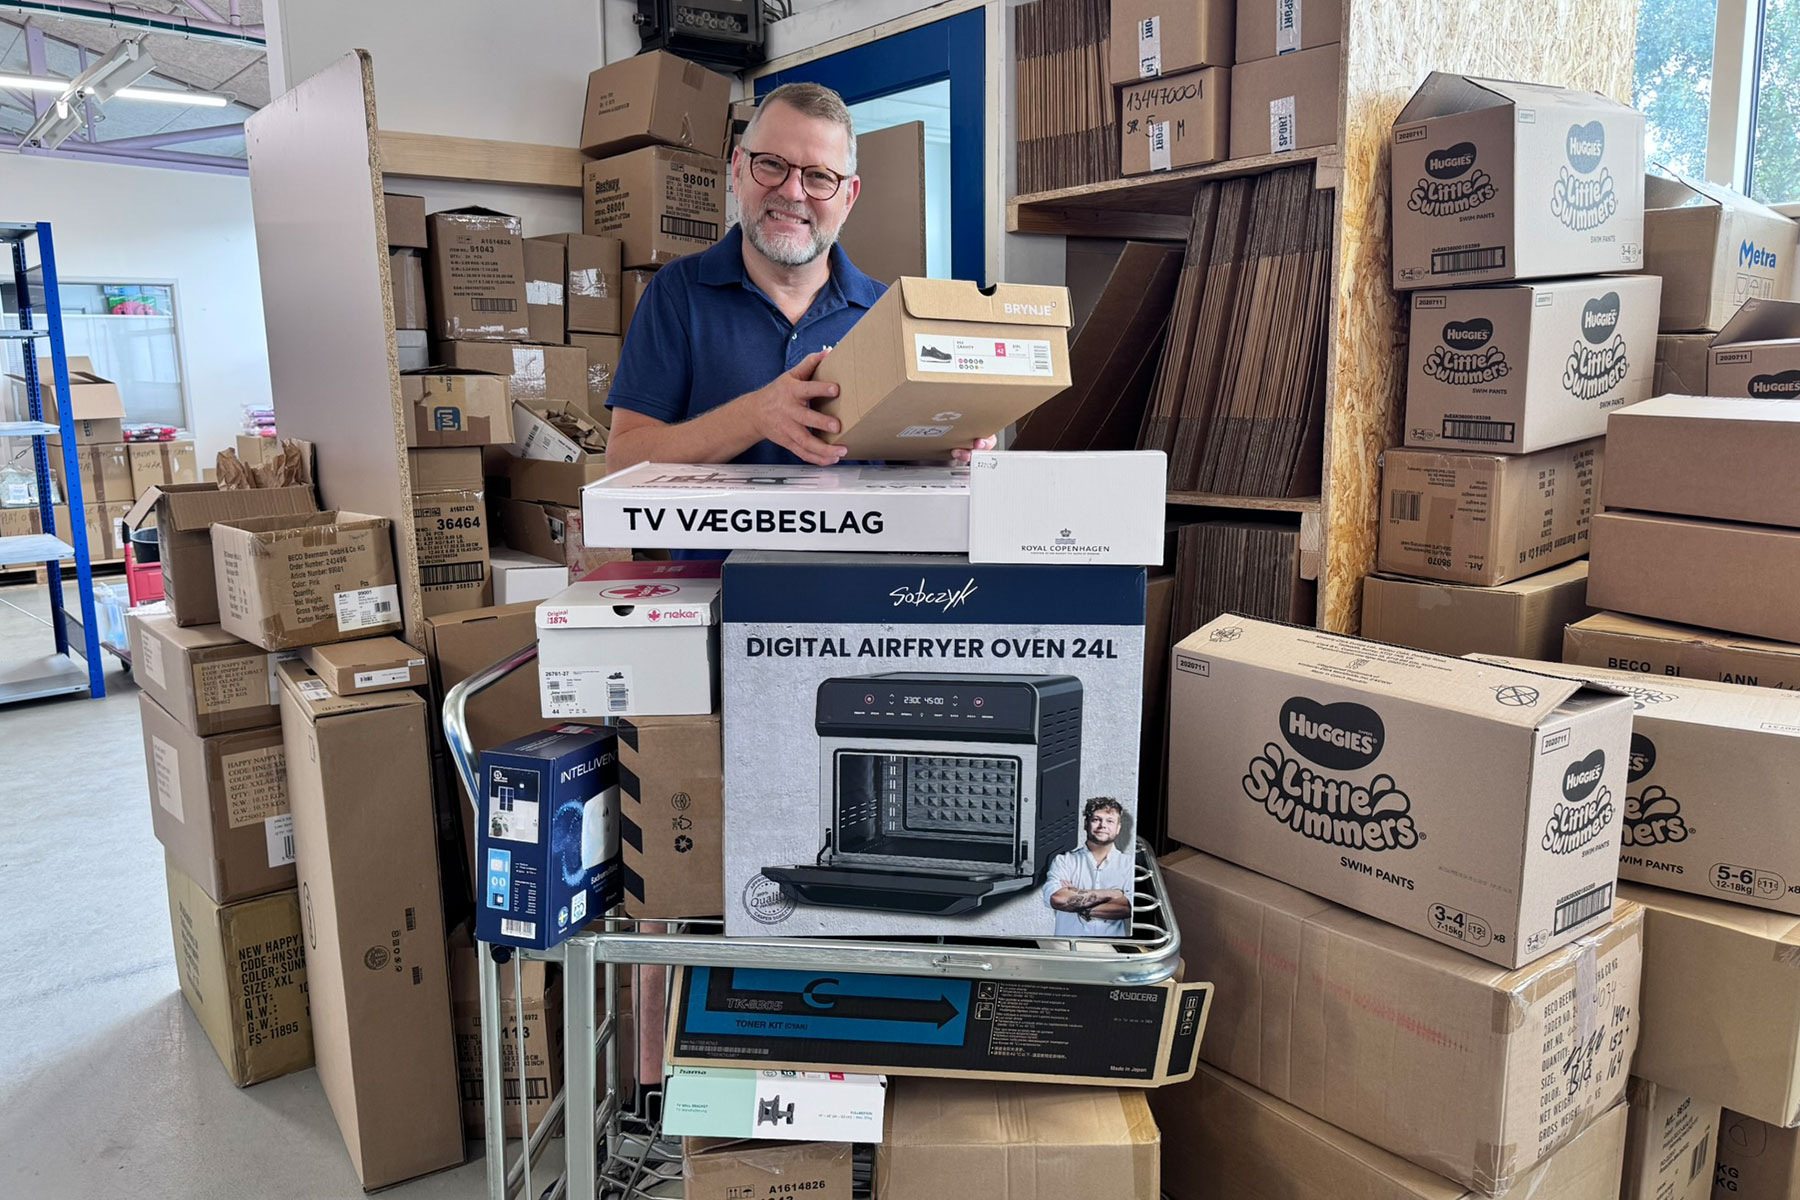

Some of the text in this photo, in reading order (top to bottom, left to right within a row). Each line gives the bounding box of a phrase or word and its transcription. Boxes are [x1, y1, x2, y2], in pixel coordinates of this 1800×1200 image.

[1126, 80, 1203, 111] 134470001
[1278, 116, 1289, 147] SPORT
[1399, 130, 1423, 139] 2020711
[1570, 138, 1601, 157] HUGGIES
[1430, 156, 1472, 171] HUGGIES
[683, 173, 716, 188] 98001
[1427, 179, 1473, 201] Little
[1567, 175, 1601, 206] Little
[1408, 186, 1495, 217] Swimmers
[1551, 181, 1616, 231] Swimmers
[1459, 212, 1495, 222] SWIM PANTS
[1739, 239, 1776, 269] Metra
[1400, 269, 1413, 277] 3-4
[1004, 303, 1052, 316] BRYNJE
[1585, 312, 1617, 329] HUGGIES
[1447, 329, 1488, 340] HUGGIES
[1423, 354, 1508, 385] Swimmers
[1443, 351, 1487, 371] Little
[1580, 348, 1613, 376] Little
[1563, 354, 1627, 400] Swimmers
[1753, 381, 1800, 393] HUGGIES
[437, 517, 480, 530] 36464
[623, 507, 884, 534] TV VÆGBESLAG
[288, 553, 303, 561] BECO
[305, 551, 329, 559] Beermann
[289, 563, 303, 571] Order
[889, 577, 979, 613] Sobczyk
[296, 607, 311, 615] Gross
[297, 615, 314, 624] Carton
[547, 609, 699, 619] Original rieker
[549, 617, 568, 625] 1874
[747, 637, 1118, 659] DIGITAL AIRFRYER OVEN 24L
[1180, 659, 1206, 673] 2020711
[1608, 656, 1651, 672] BECO
[1289, 711, 1374, 755] HUGGIES
[228, 755, 277, 769] HAPPY NAPPY
[560, 749, 618, 784] INTELLIVEN
[1282, 757, 1372, 816] Little
[1566, 767, 1602, 791] HUGGIES
[1242, 756, 1418, 851] Swimmers
[1560, 800, 1598, 833] Little
[1542, 803, 1613, 855] Swimmers
[1340, 856, 1373, 876] SWIM
[1376, 868, 1415, 891] PANTS
[1619, 855, 1684, 875] WIM PANTS
[1717, 865, 1754, 885] 5-6
[1762, 880, 1773, 889] 11
[1716, 879, 1753, 895] 12-18kg
[1434, 905, 1465, 928] 3-4
[1437, 921, 1463, 940] 7-15kg
[1473, 926, 1506, 944] 12 x8
[238, 934, 299, 960] NEW HAPPY
[242, 966, 279, 985] COLOR:
[244, 974, 294, 997] SIZE: XXL
[802, 977, 840, 1009] C
[1120, 991, 1158, 1002] KYOCERA
[1544, 999, 1559, 1019] BECO
[736, 1020, 767, 1029] TONER
[769, 1022, 784, 1030] KIT
[1539, 1109, 1551, 1126] NET
[1716, 1162, 1739, 1179] KG
[769, 1181, 826, 1194] A1614826
[1715, 1177, 1737, 1192] KG
